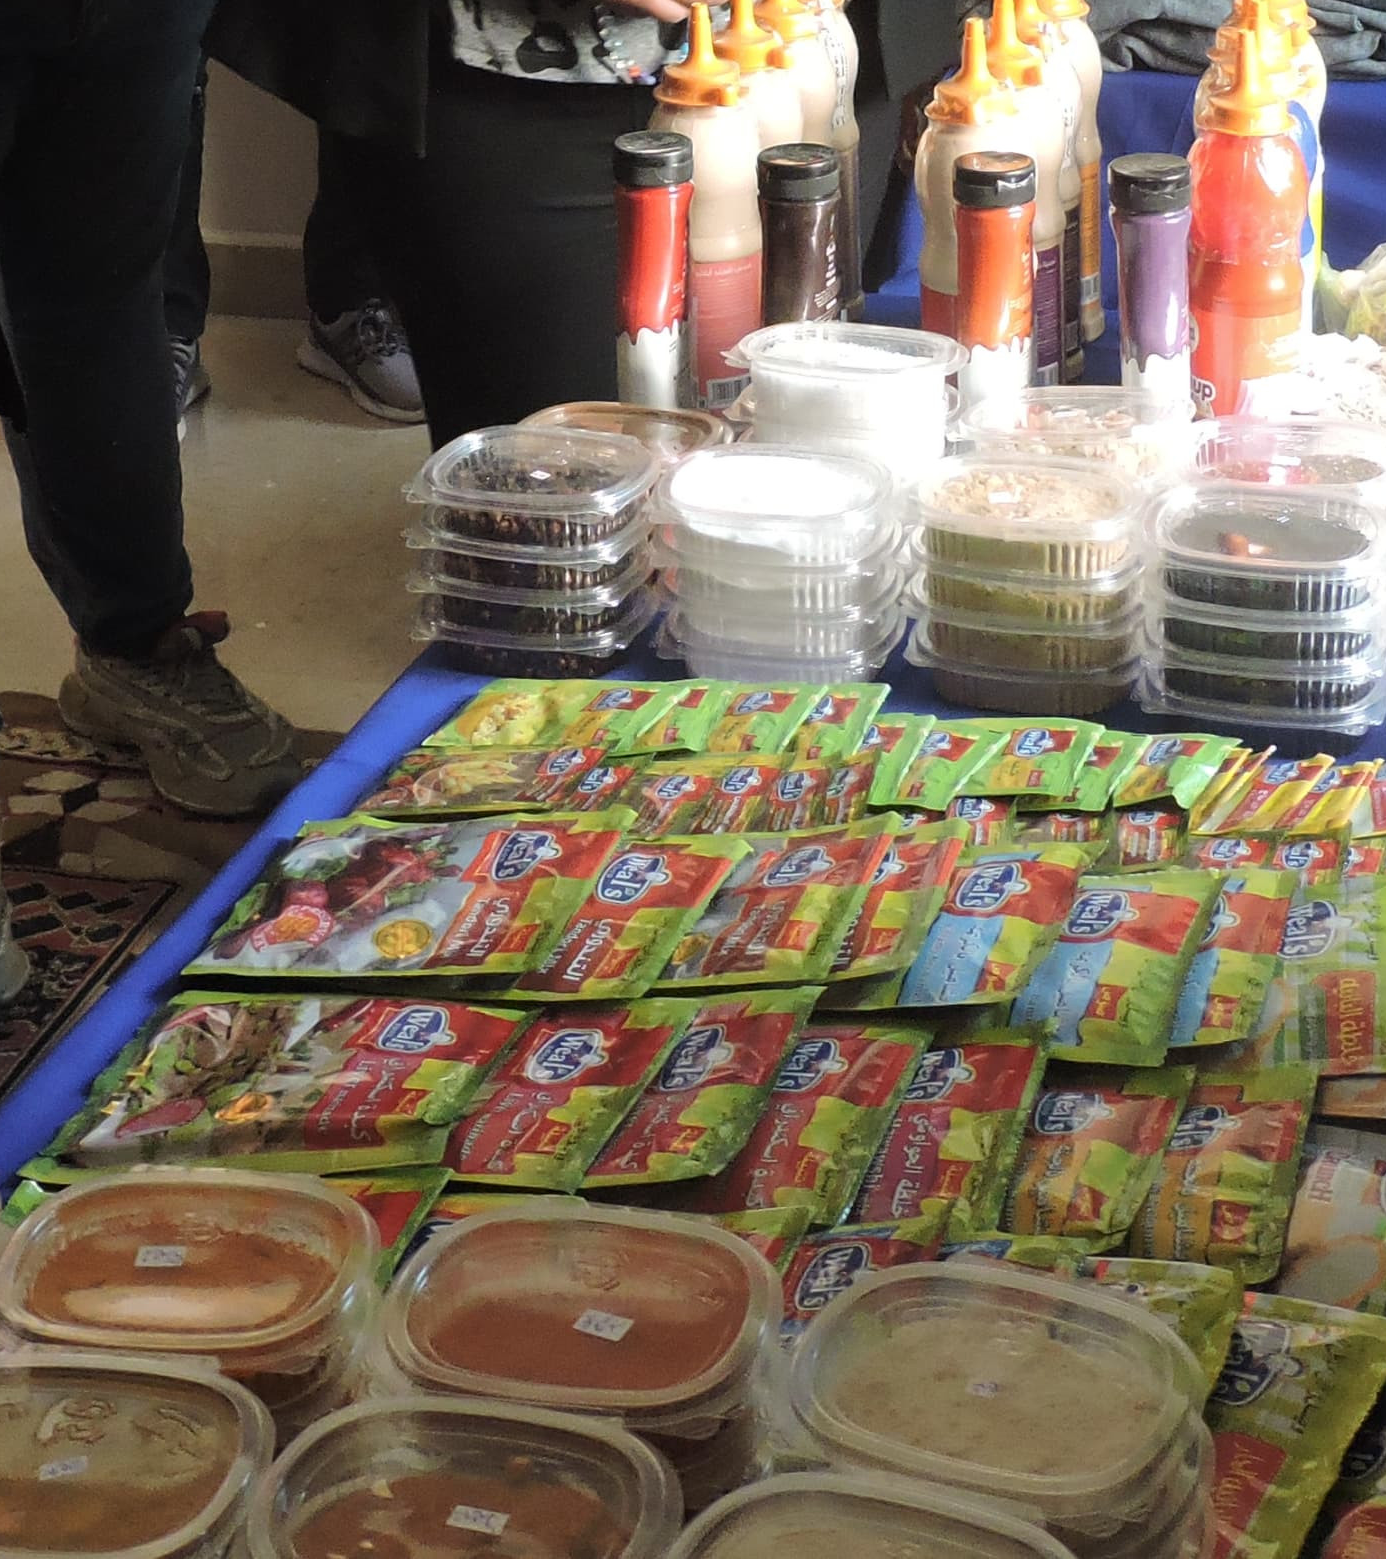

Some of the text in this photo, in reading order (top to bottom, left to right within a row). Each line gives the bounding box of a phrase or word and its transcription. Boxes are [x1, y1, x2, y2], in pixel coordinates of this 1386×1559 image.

[1018, 730, 1042, 756] Weal's
[602, 857, 653, 898] Weal's
[965, 866, 1005, 906] Weal's
[1069, 894, 1114, 934] Weal's
[1283, 903, 1326, 954] Weal's
[562, 918, 614, 981] التندوري
[385, 1012, 434, 1050] Weal's
[534, 1035, 588, 1078] Weal's
[665, 1031, 711, 1087] Weal's
[777, 1042, 823, 1089] Weal's
[906, 1051, 947, 1101] Weal's
